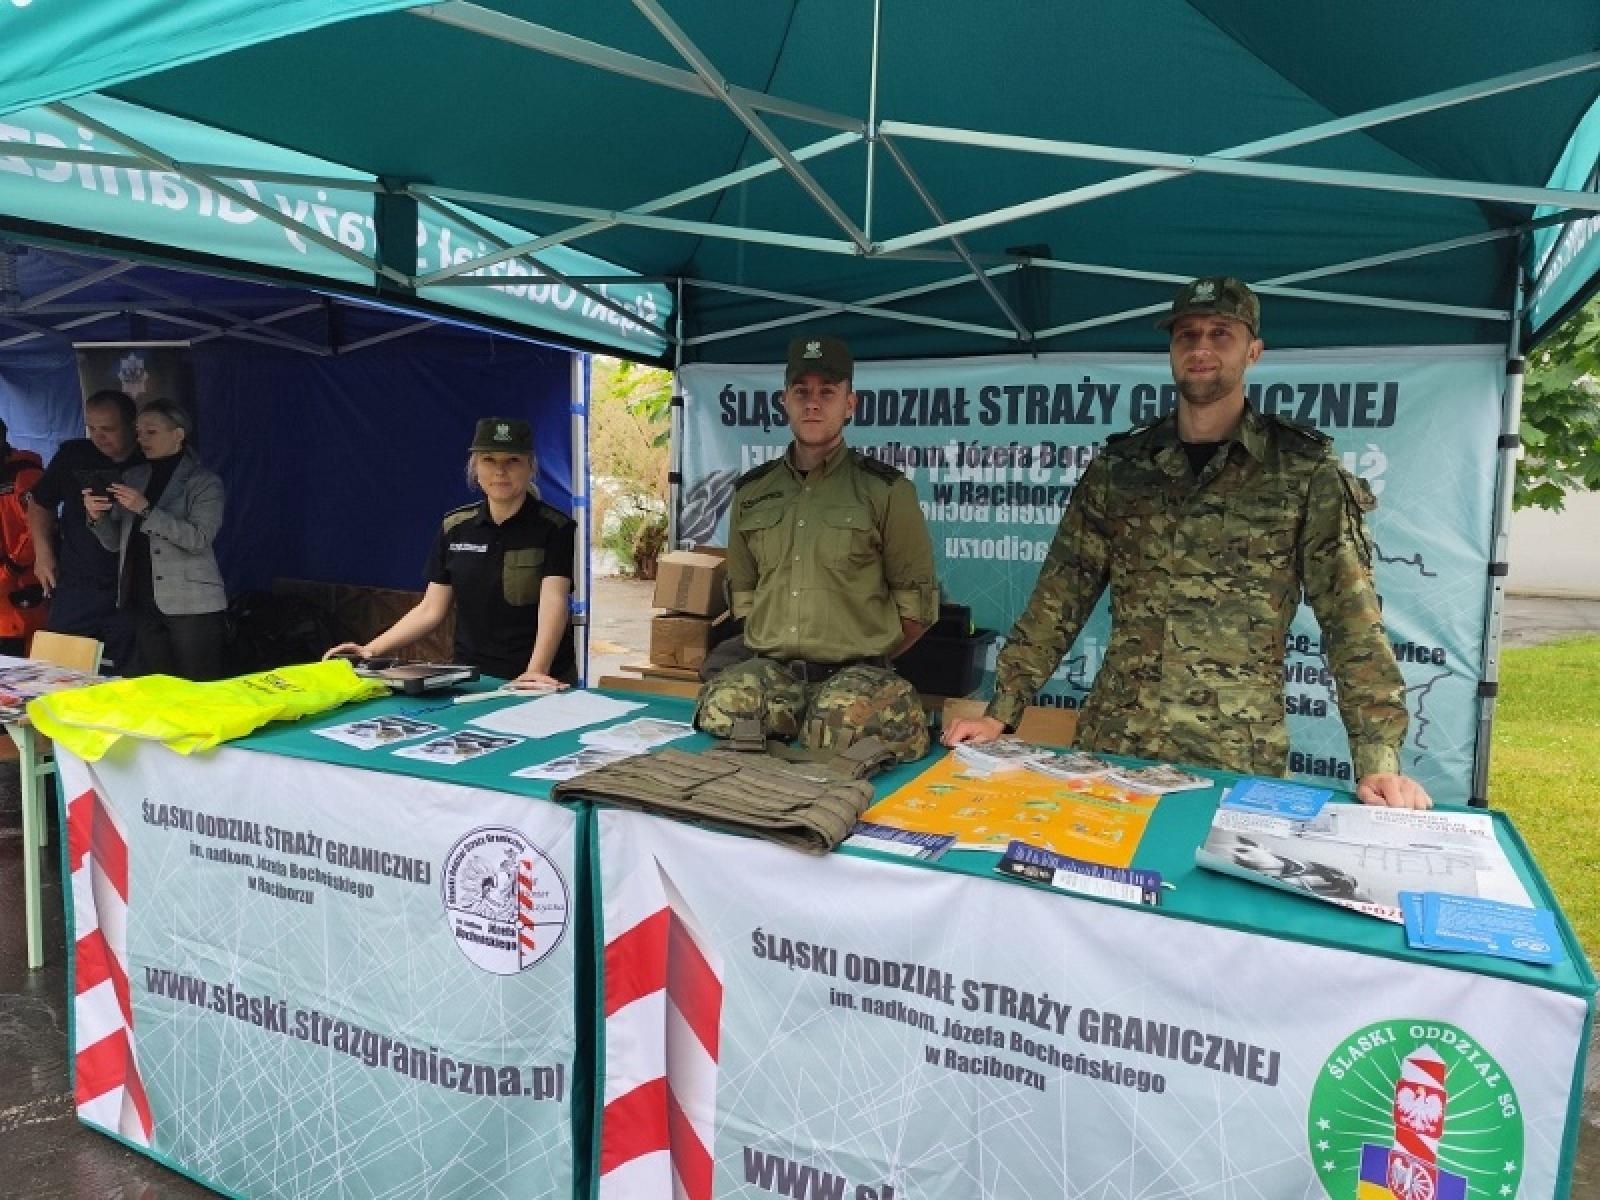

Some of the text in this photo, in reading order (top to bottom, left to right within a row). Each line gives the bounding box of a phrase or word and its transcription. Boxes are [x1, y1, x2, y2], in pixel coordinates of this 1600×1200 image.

[719, 376, 1399, 432] ŚLĄS DDZIAŁ STRAŻY GRICZNEJ
[956, 440, 1032, 469] Józefa
[933, 481, 1073, 508] w Raciborz
[142, 797, 431, 885] ŚLĄSKI ODDZIAŁ STRAŻY GRANICZNEJ
[144, 965, 565, 1103] www.slaski.strazgraniczna.pl
[751, 926, 1281, 1087] ŚLĄSKI ODDZIAŁ STRAŻY GRANICZNEJ
[829, 987, 1167, 1094] im. nadkom. Józefa Bocheńskiego
[925, 1044, 1047, 1092] w Raciborzu
